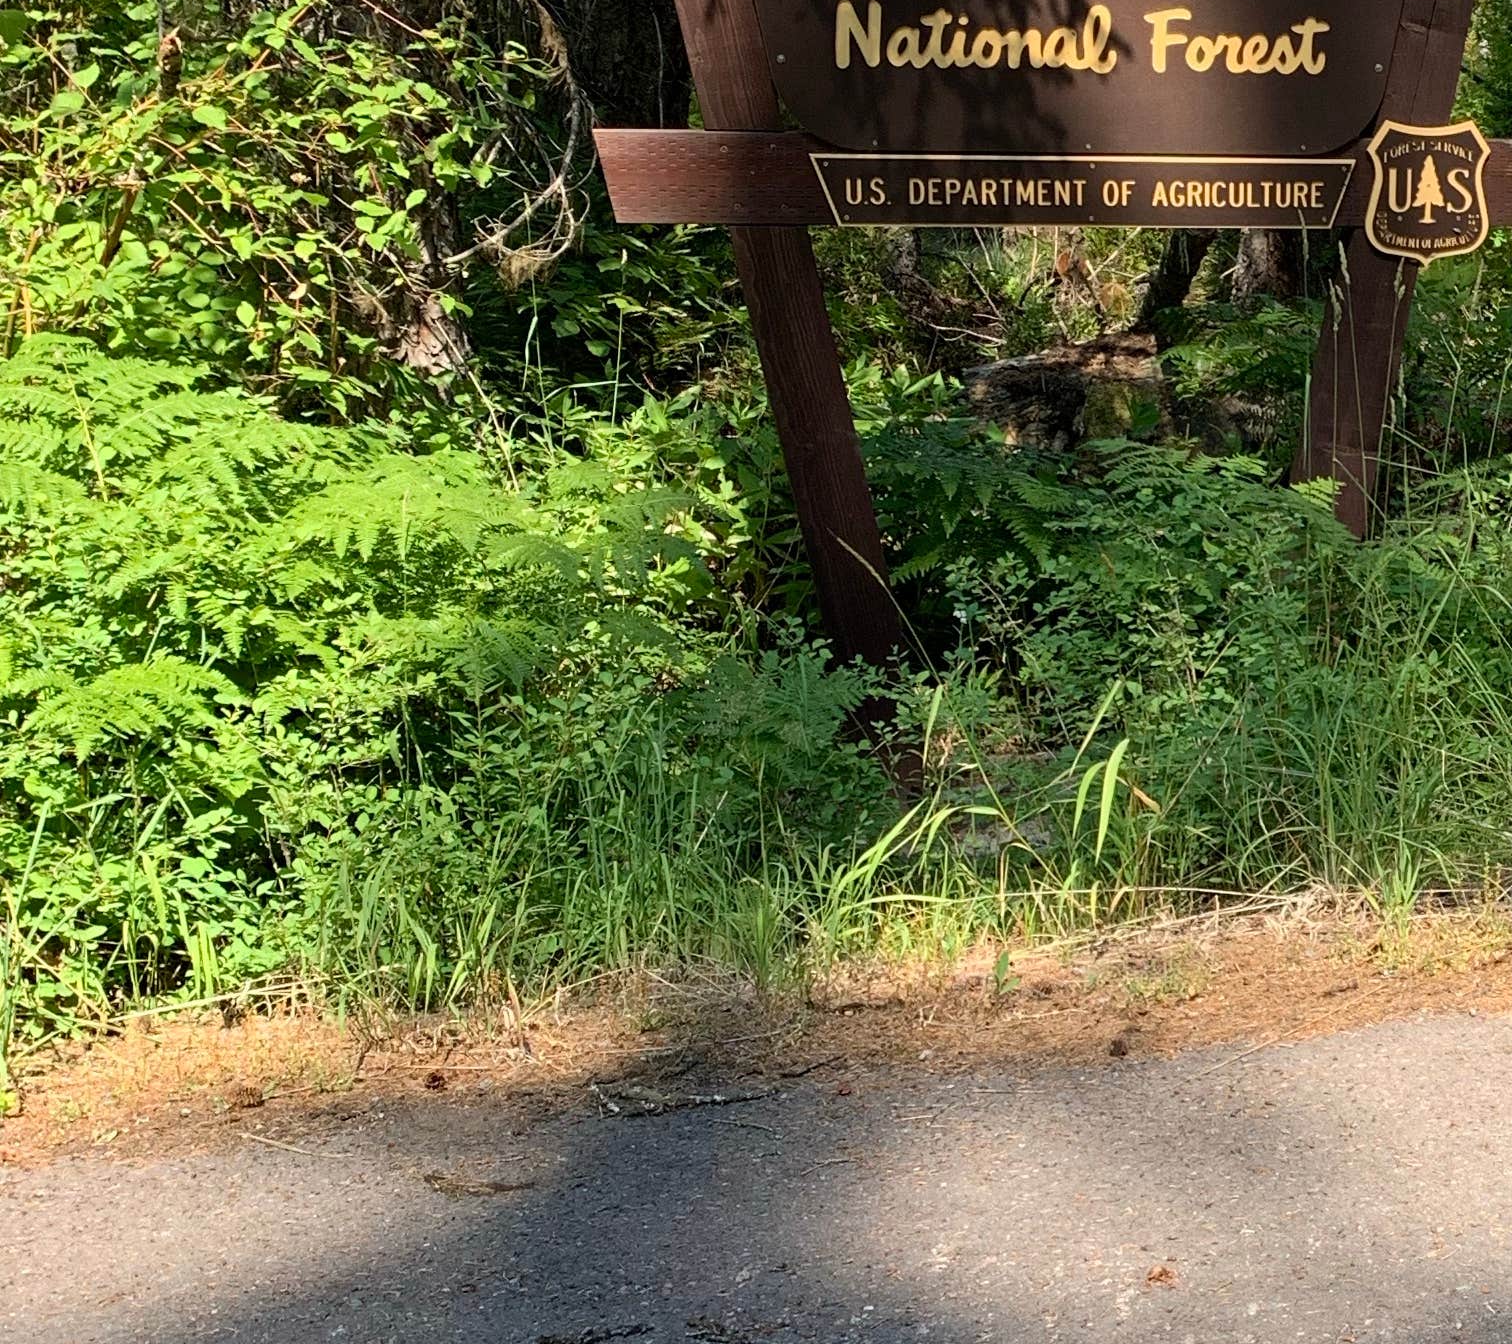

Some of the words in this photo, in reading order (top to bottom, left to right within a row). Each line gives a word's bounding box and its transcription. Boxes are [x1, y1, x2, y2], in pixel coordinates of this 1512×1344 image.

[835, 0, 1117, 75] National
[1143, 8, 1330, 75] Forest
[845, 177, 892, 206] U.S.
[908, 177, 1087, 207] DEPARTMENT
[1102, 180, 1136, 207] OF
[1151, 181, 1325, 208] AGRICULTURE
